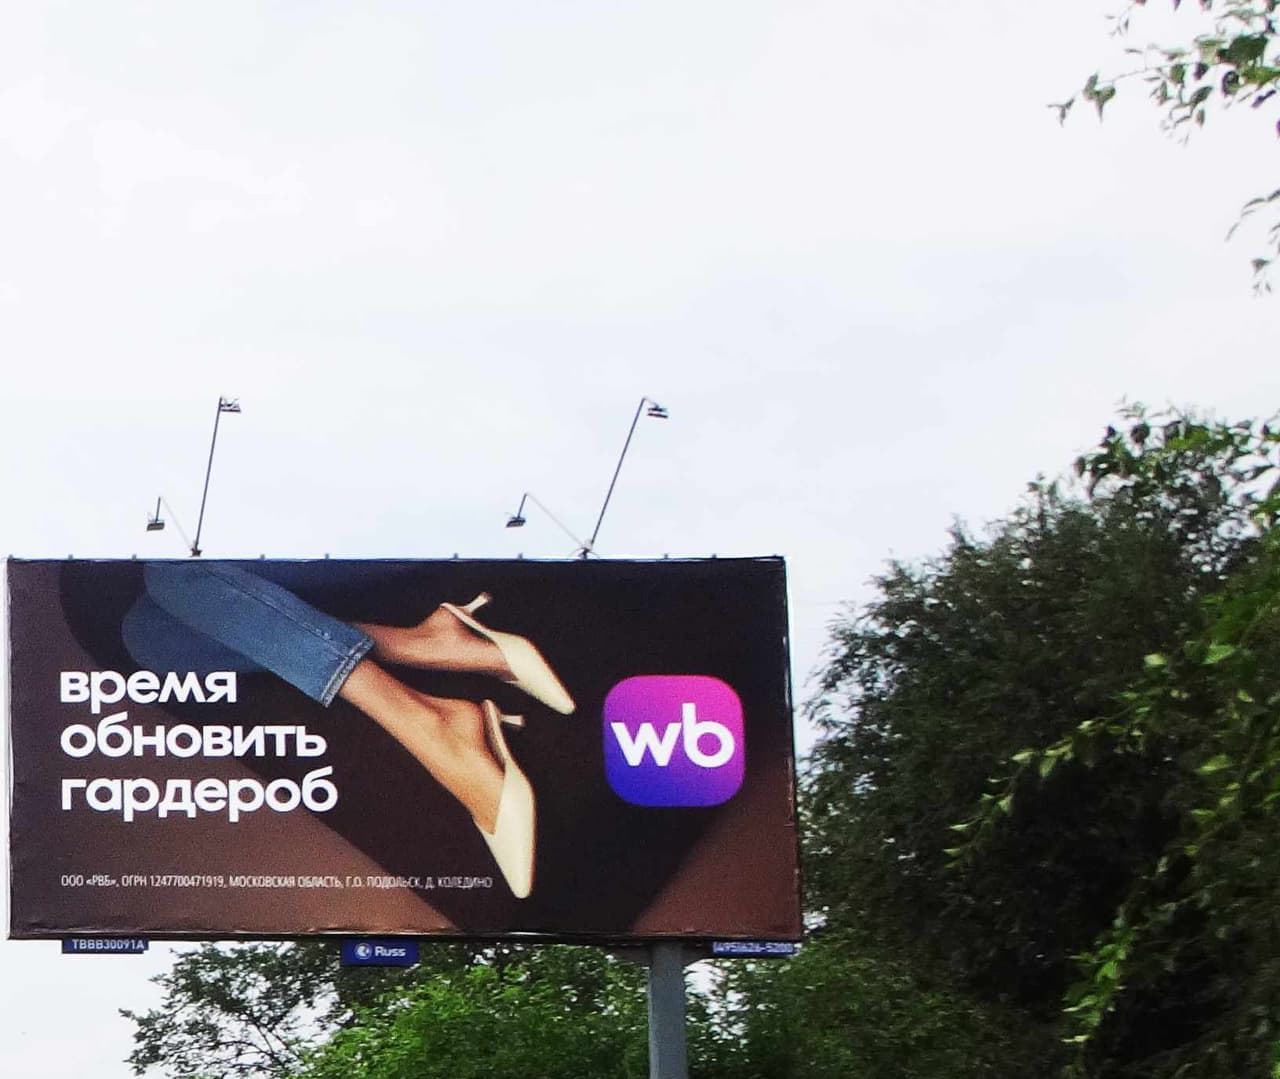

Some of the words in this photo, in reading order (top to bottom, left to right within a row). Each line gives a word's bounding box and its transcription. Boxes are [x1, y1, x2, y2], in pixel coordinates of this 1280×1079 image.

[60, 670, 237, 713] время
[60, 712, 327, 758] обновить
[610, 703, 735, 768] wb
[60, 766, 339, 822] гардероб
[61, 875, 84, 887] ООО
[121, 875, 148, 887] ОГРН
[229, 875, 296, 888] МОСКОВСКАЯ
[297, 876, 344, 889] ОБЛАСТЬ,
[366, 876, 423, 890] ПОДОЛЬСК,
[437, 876, 493, 890] КОЛЕДИНО
[374, 945, 407, 958] Russ
